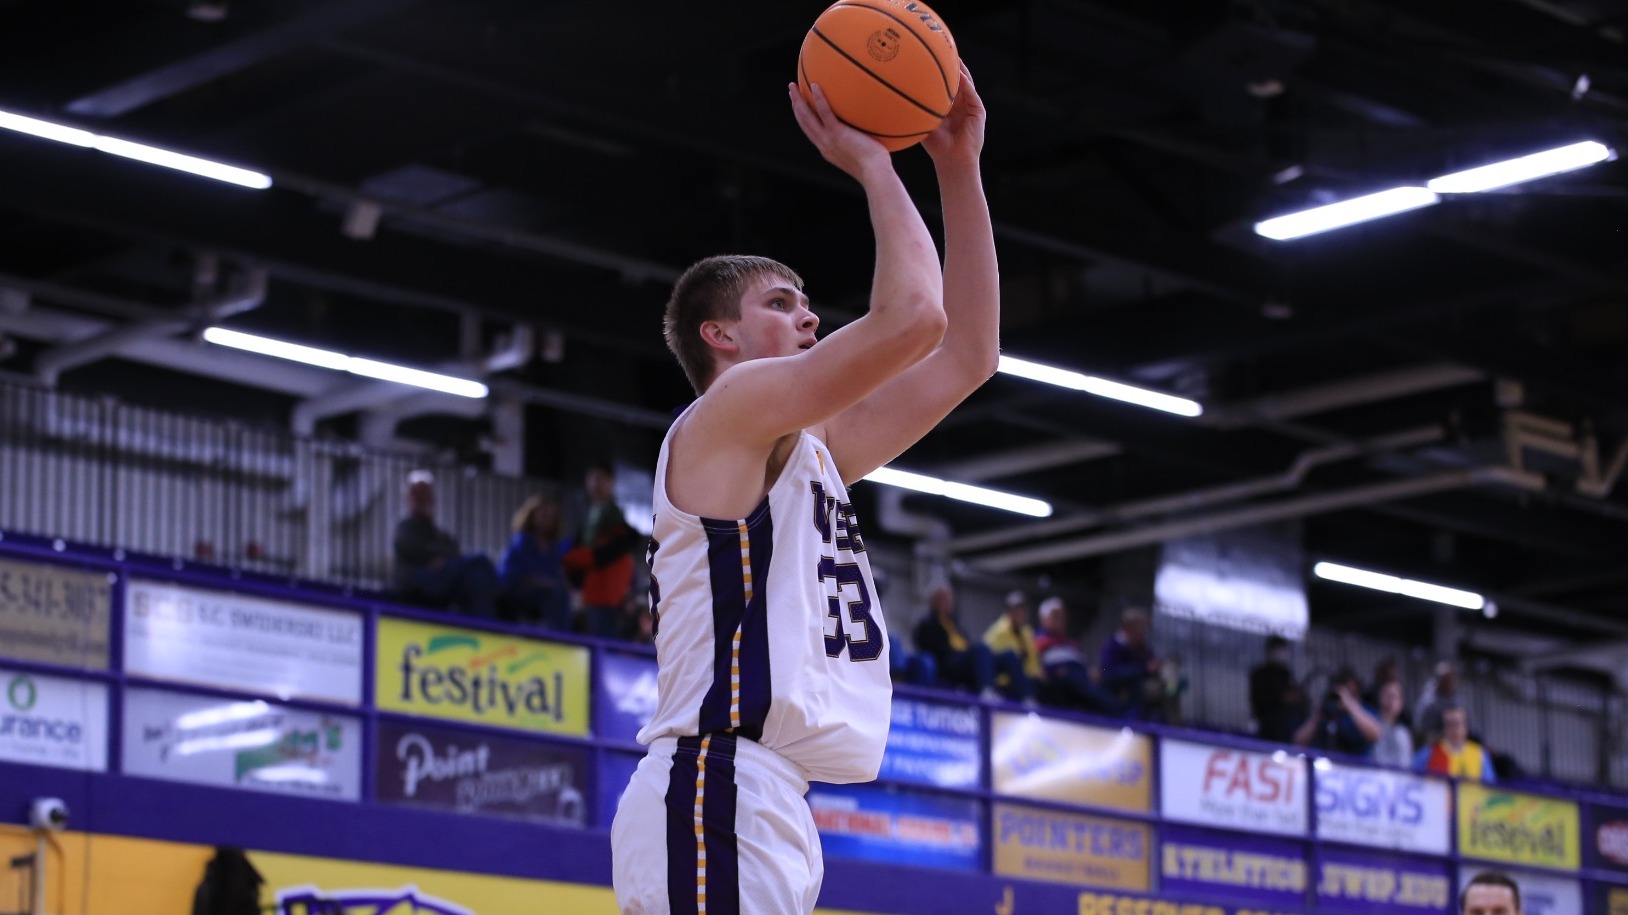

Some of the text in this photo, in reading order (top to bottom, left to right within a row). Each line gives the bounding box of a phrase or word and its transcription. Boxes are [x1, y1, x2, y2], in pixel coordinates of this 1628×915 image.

[817, 554, 884, 662] 33
[398, 645, 564, 723] festival
[396, 733, 490, 798] Point
[1203, 750, 1297, 807] FAST
[1315, 772, 1423, 824] SIGNS
[1000, 811, 1144, 861] POINTERS
